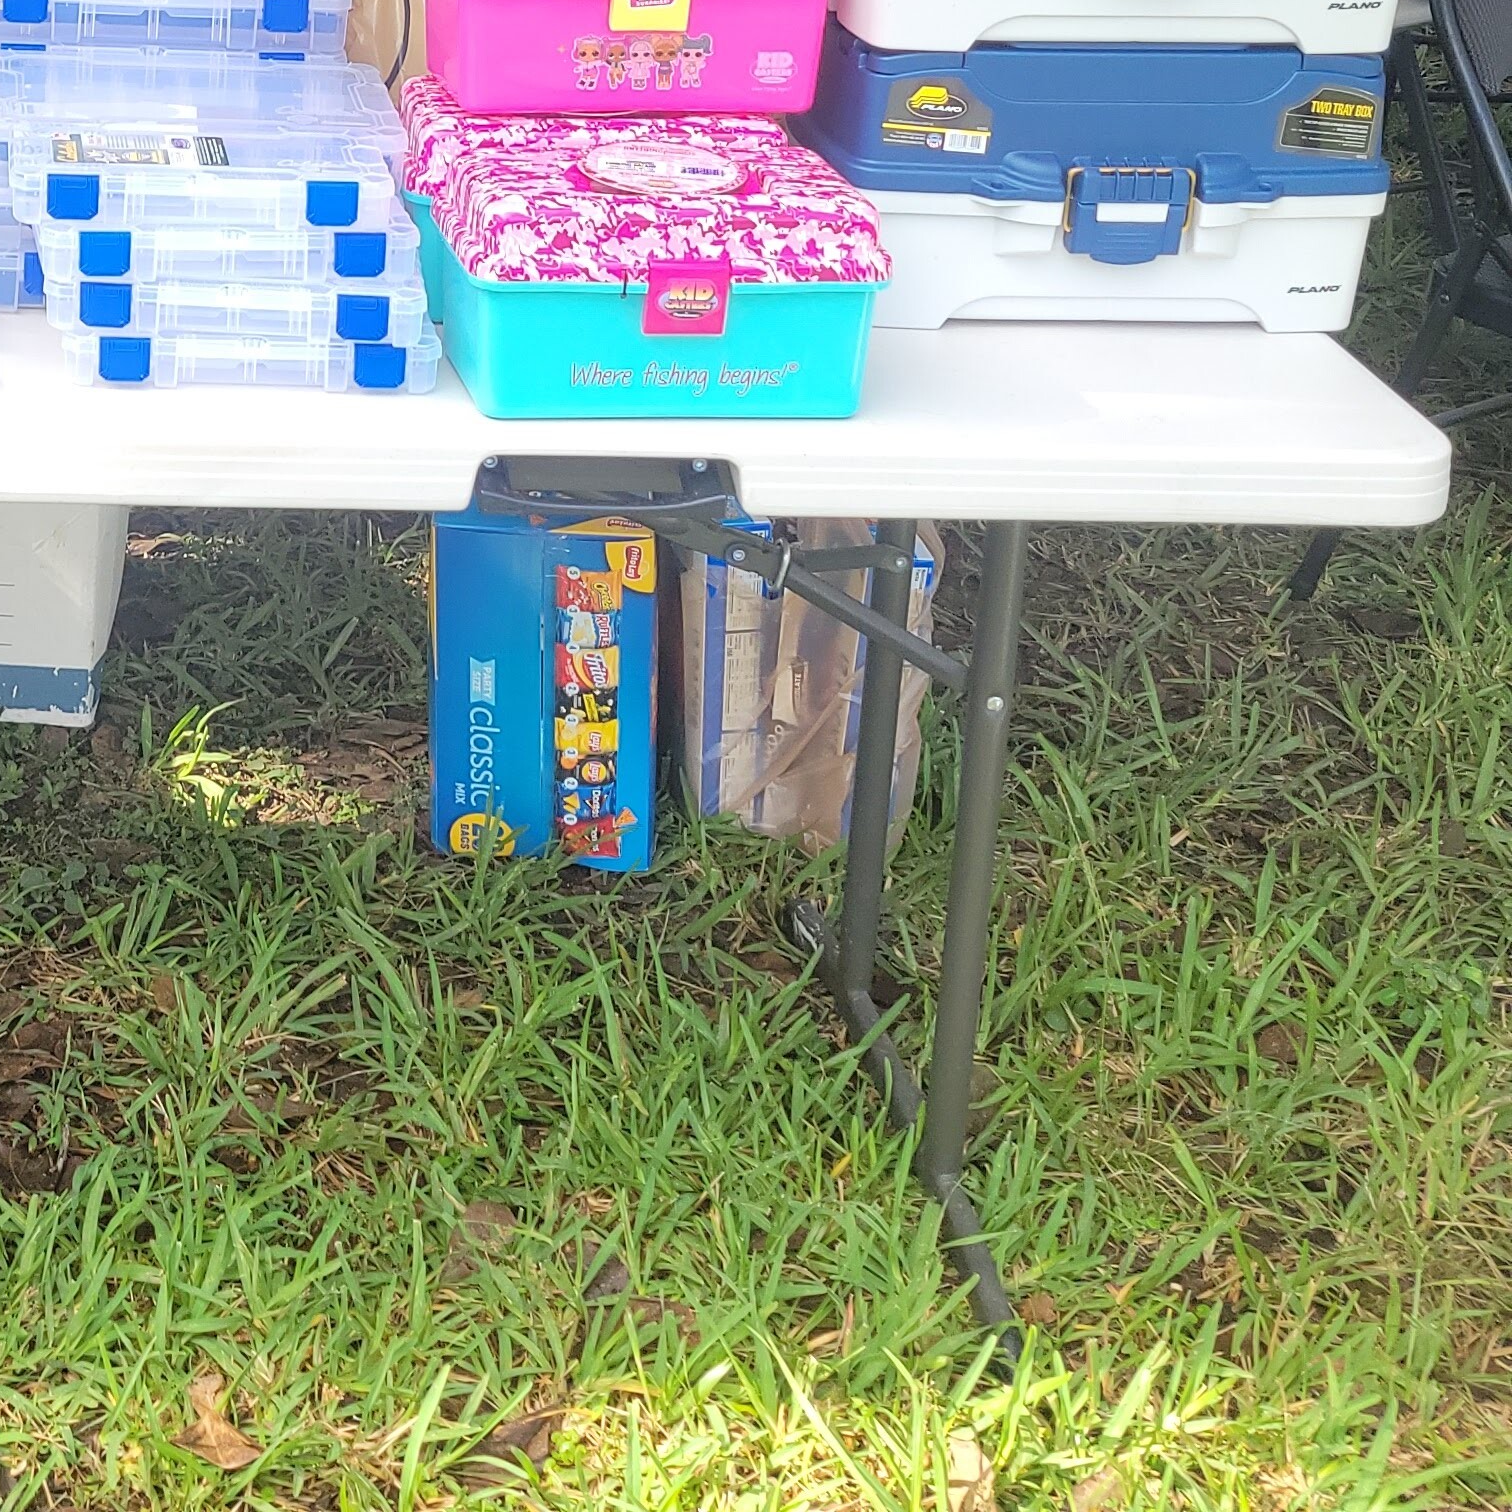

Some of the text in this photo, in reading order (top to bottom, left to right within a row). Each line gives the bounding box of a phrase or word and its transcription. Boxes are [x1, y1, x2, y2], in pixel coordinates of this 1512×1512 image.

[1327, 1, 1382, 10] PLANO
[1310, 100, 1374, 118] TWO TRAY BOX
[668, 281, 716, 301] KID
[1287, 284, 1341, 294] PLANO
[570, 362, 633, 387] Where
[643, 361, 710, 397] fishing
[471, 670, 481, 695] SIZE
[482, 666, 492, 701] PARTY
[470, 705, 500, 808] classic
[455, 781, 466, 805] MIX
[460, 823, 470, 850] BAGS
